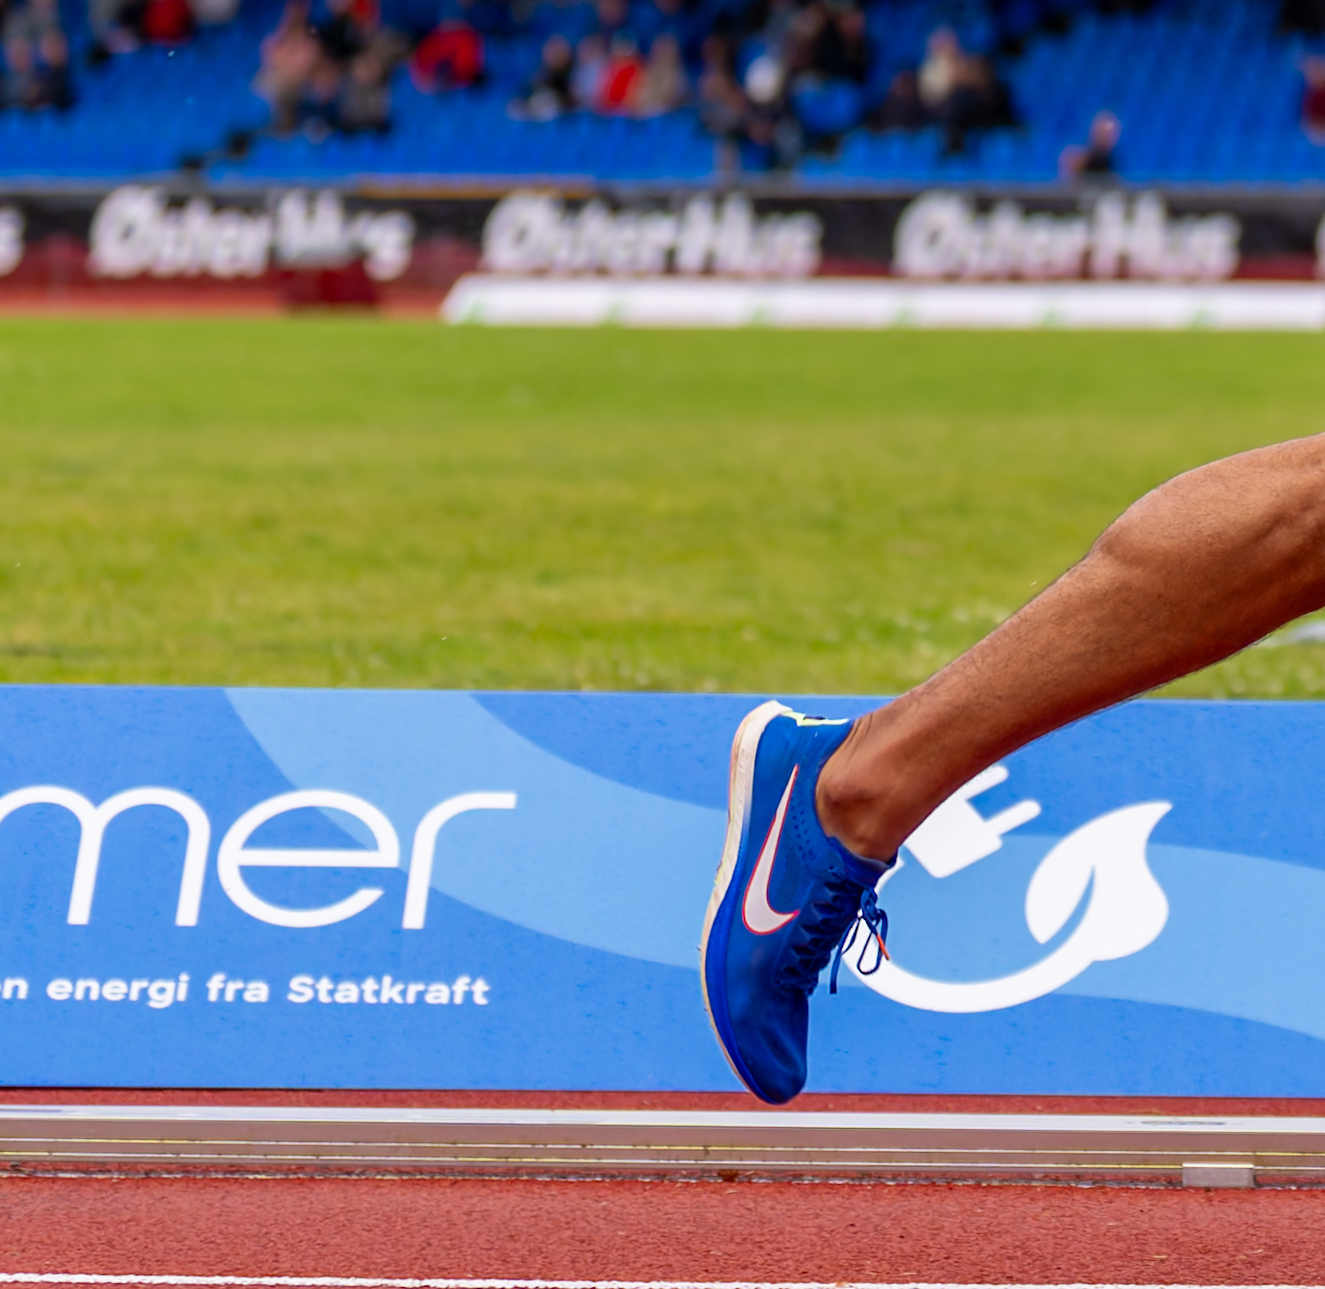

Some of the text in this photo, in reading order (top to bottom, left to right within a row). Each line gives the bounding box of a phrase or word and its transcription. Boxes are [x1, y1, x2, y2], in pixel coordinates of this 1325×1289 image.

[0, 785, 518, 930] mer
[46, 974, 190, 1009] energi
[206, 973, 270, 1004] fra
[287, 975, 491, 1006] Statkraft
